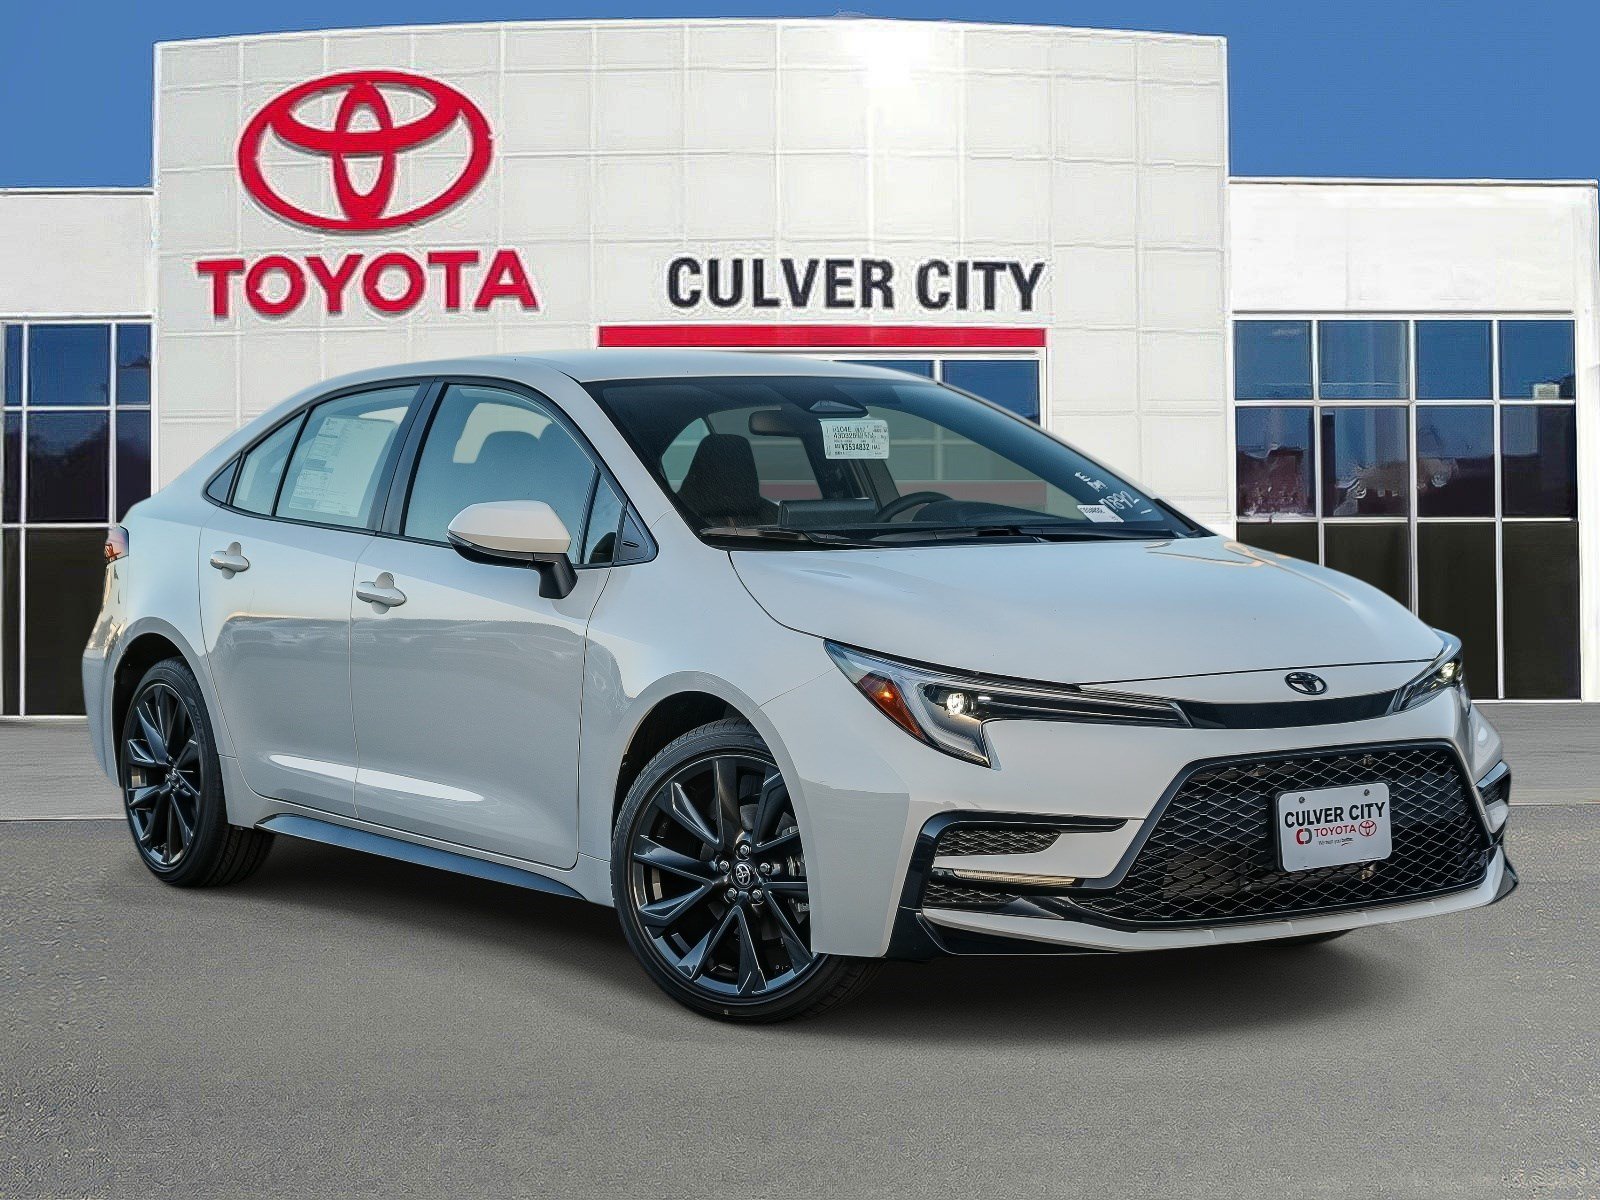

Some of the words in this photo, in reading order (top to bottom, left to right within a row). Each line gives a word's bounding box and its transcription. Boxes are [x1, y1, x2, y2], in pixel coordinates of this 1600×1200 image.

[195, 249, 541, 318] TOYOTA
[667, 257, 895, 309] CULVER
[915, 259, 1045, 311] CITY
[1284, 806, 1344, 828] CULVER
[1349, 801, 1386, 821] CITY
[1313, 824, 1357, 838] TOYOTA
